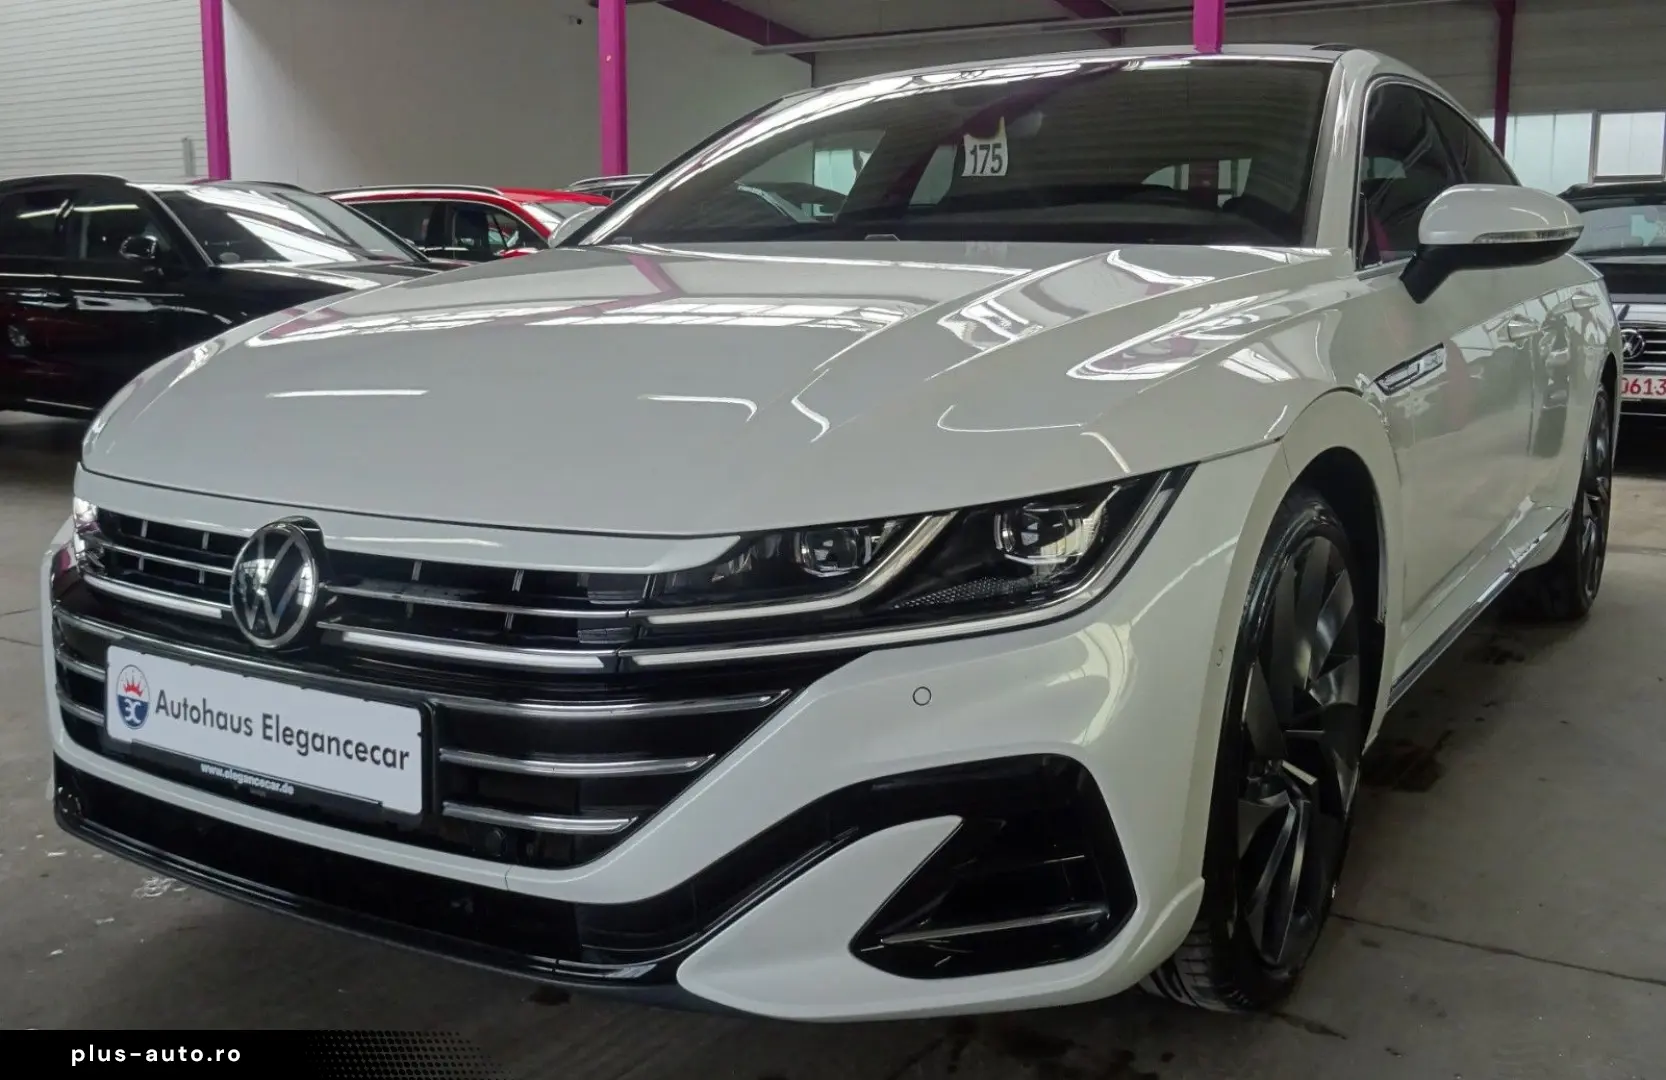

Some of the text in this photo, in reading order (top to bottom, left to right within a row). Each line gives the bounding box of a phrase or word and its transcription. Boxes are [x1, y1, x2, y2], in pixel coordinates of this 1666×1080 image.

[970, 143, 1003, 174] 175
[155, 689, 410, 770] Autohaus Elegancecar
